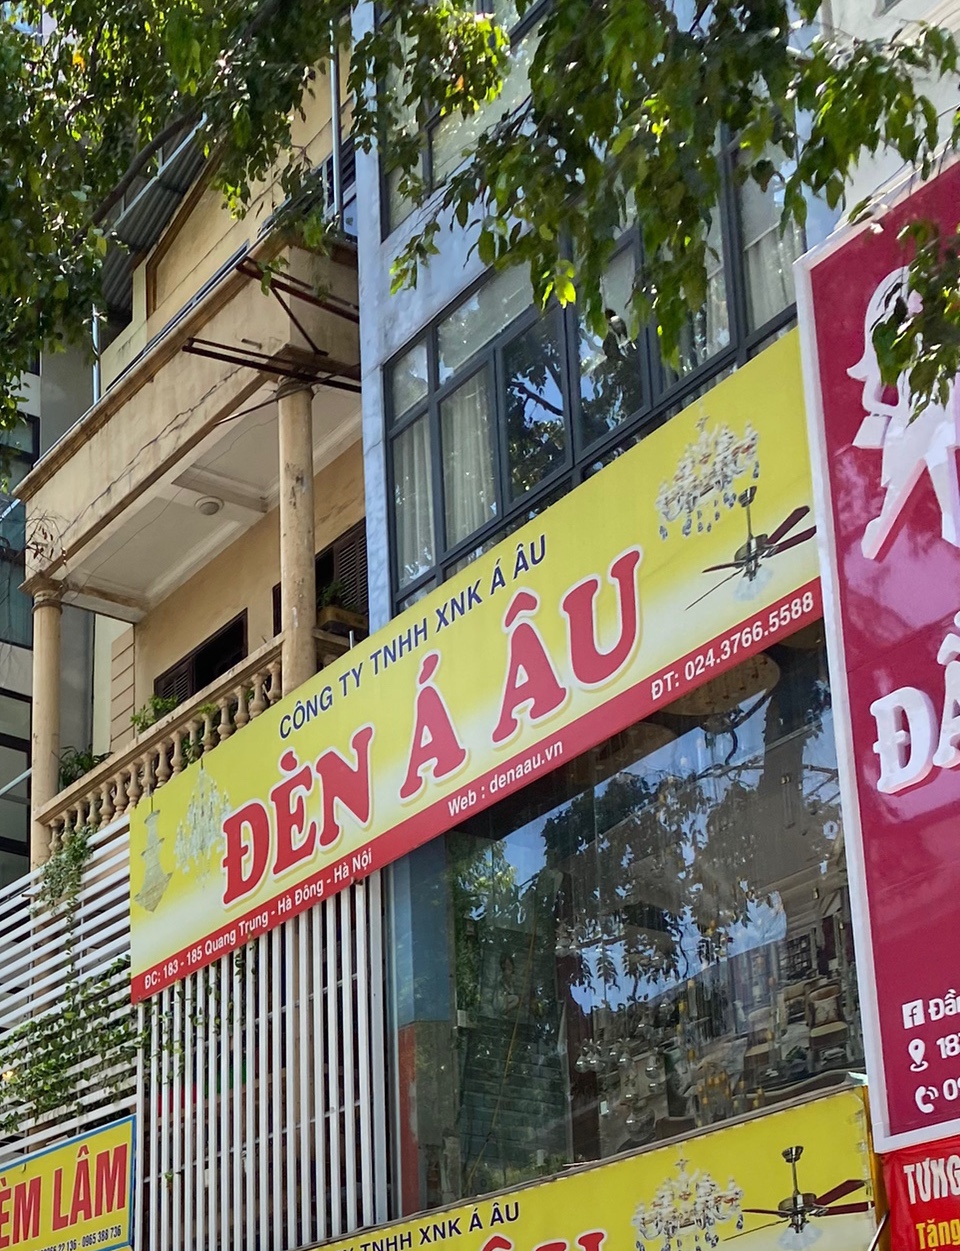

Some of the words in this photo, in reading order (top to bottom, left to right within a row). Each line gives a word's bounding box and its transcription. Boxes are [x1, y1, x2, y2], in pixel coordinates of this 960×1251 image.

[279, 693, 333, 738] CÔNG
[339, 672, 365, 701] TY
[370, 619, 428, 678] TNHH
[435, 584, 484, 633] XNK
[488, 562, 507, 594] Á
[512, 534, 548, 580] ÂU
[650, 670, 681, 702] ĐT:
[683, 592, 816, 682] 024.3766.5588
[221, 725, 374, 905] ĐÈN
[400, 652, 466, 800] Á
[492, 548, 642, 743] ÂU
[447, 790, 478, 817] Web
[488, 740, 563, 795] denaau.vn
[144, 971, 161, 990] ĐC:
[163, 962, 179, 979] 183
[186, 950, 203, 966] 185
[204, 929, 236, 955] Quang
[238, 912, 269, 936] Trung
[278, 898, 292, 916] Hà
[295, 880, 324, 905] Đông
[333, 866, 350, 883] Hà
[352, 848, 373, 872] Nội
[936, 1033, 960, 1059] 18
[52, 1143, 128, 1232] LÂM
[419, 1217, 461, 1246] XNK
[469, 1207, 484, 1232] Á
[488, 1201, 520, 1227] ÂU
[66, 1239, 77, 1251] 136
[82, 1233, 97, 1247] 0965
[110, 1225, 122, 1238] 736
